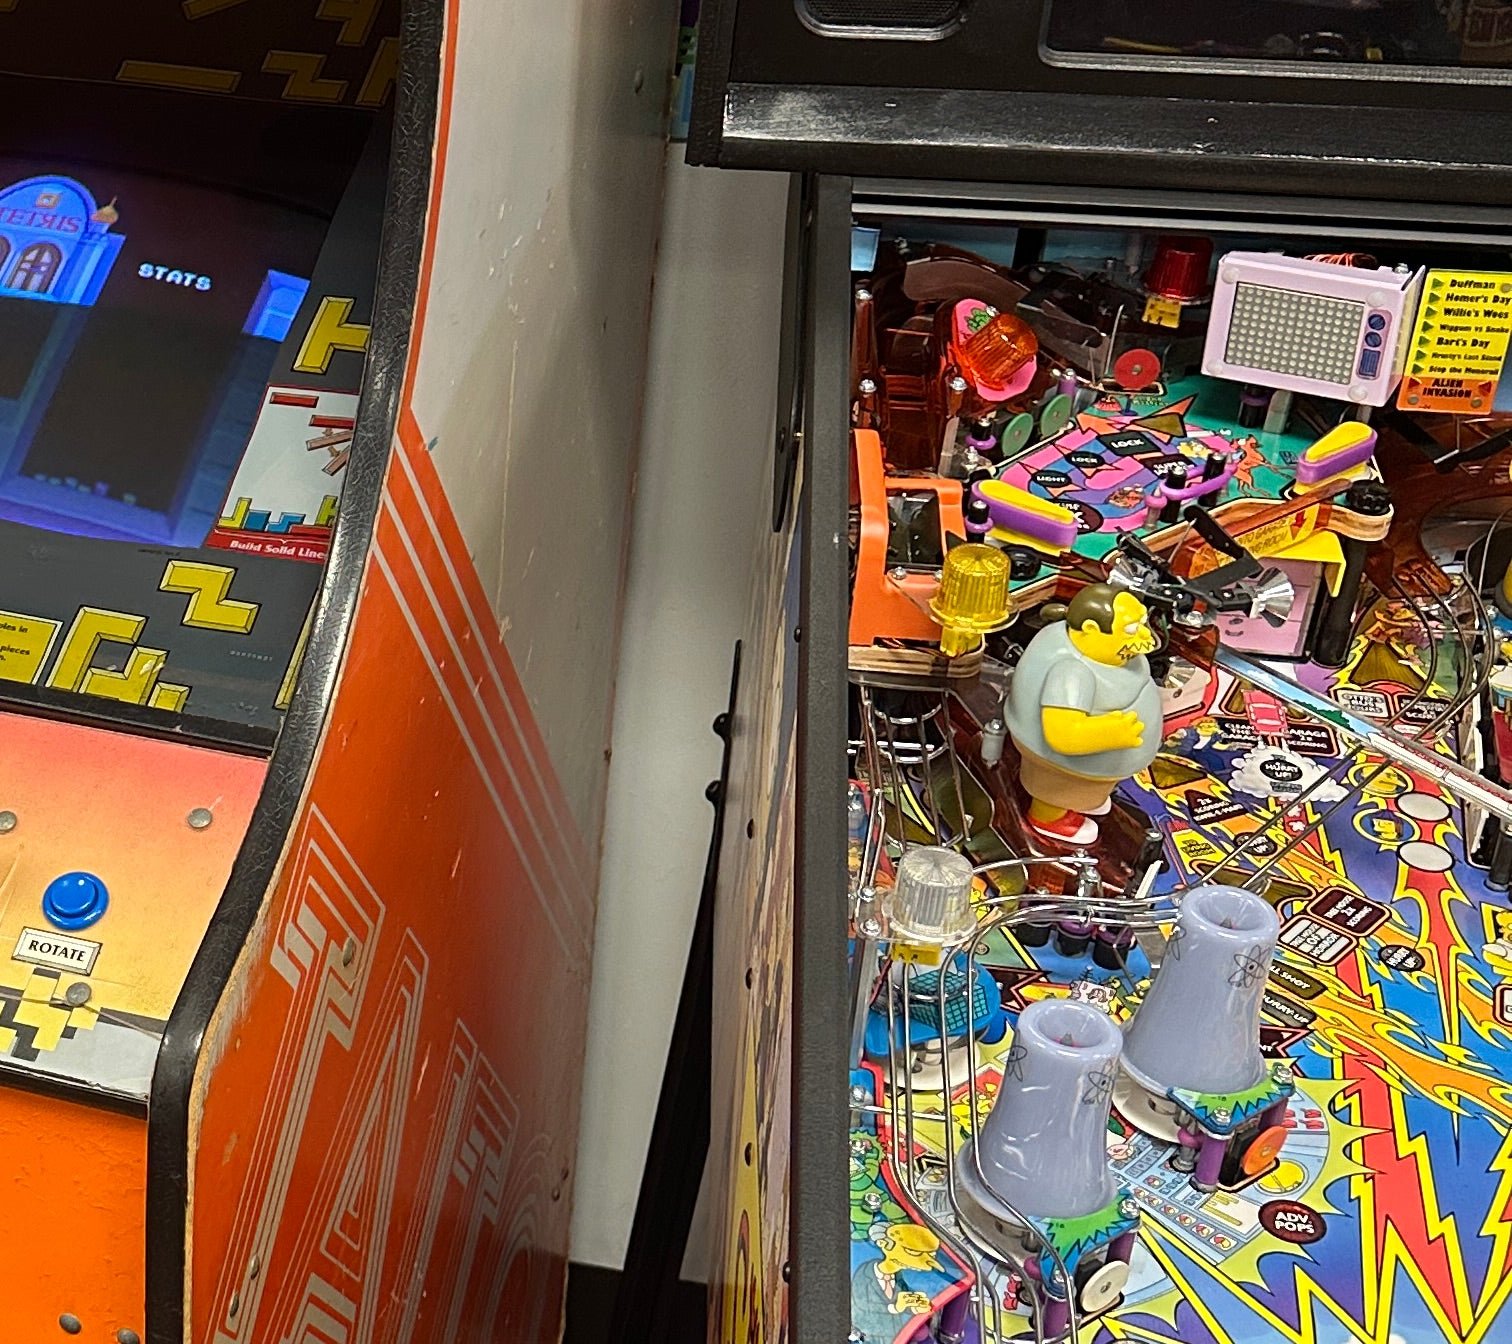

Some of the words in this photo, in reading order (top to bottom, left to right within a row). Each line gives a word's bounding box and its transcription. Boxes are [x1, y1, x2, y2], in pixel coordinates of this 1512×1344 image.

[138, 262, 213, 292] STATS
[1449, 278, 1496, 290] Duffman
[1445, 293, 1489, 304] Homer's
[1492, 295, 1512, 305] Day
[1443, 307, 1480, 318] Willie's
[1436, 337, 1468, 346] Bart's
[1470, 337, 1491, 349] Day
[1431, 378, 1464, 388] ALIEN
[1422, 388, 1473, 399] INVASION
[1110, 438, 1145, 449] LOCK
[1071, 455, 1098, 464] LOCK
[1036, 475, 1068, 483] LIGHT
[229, 540, 262, 552] Build
[264, 545, 296, 556] Solid
[18, 625, 29, 634] in
[0, 644, 31, 657] pieces
[27, 938, 88, 963] ROTATE
[1280, 971, 1311, 989] SHOT
[1275, 1211, 1313, 1225] ADV.
[1274, 1220, 1315, 1234] POPS
